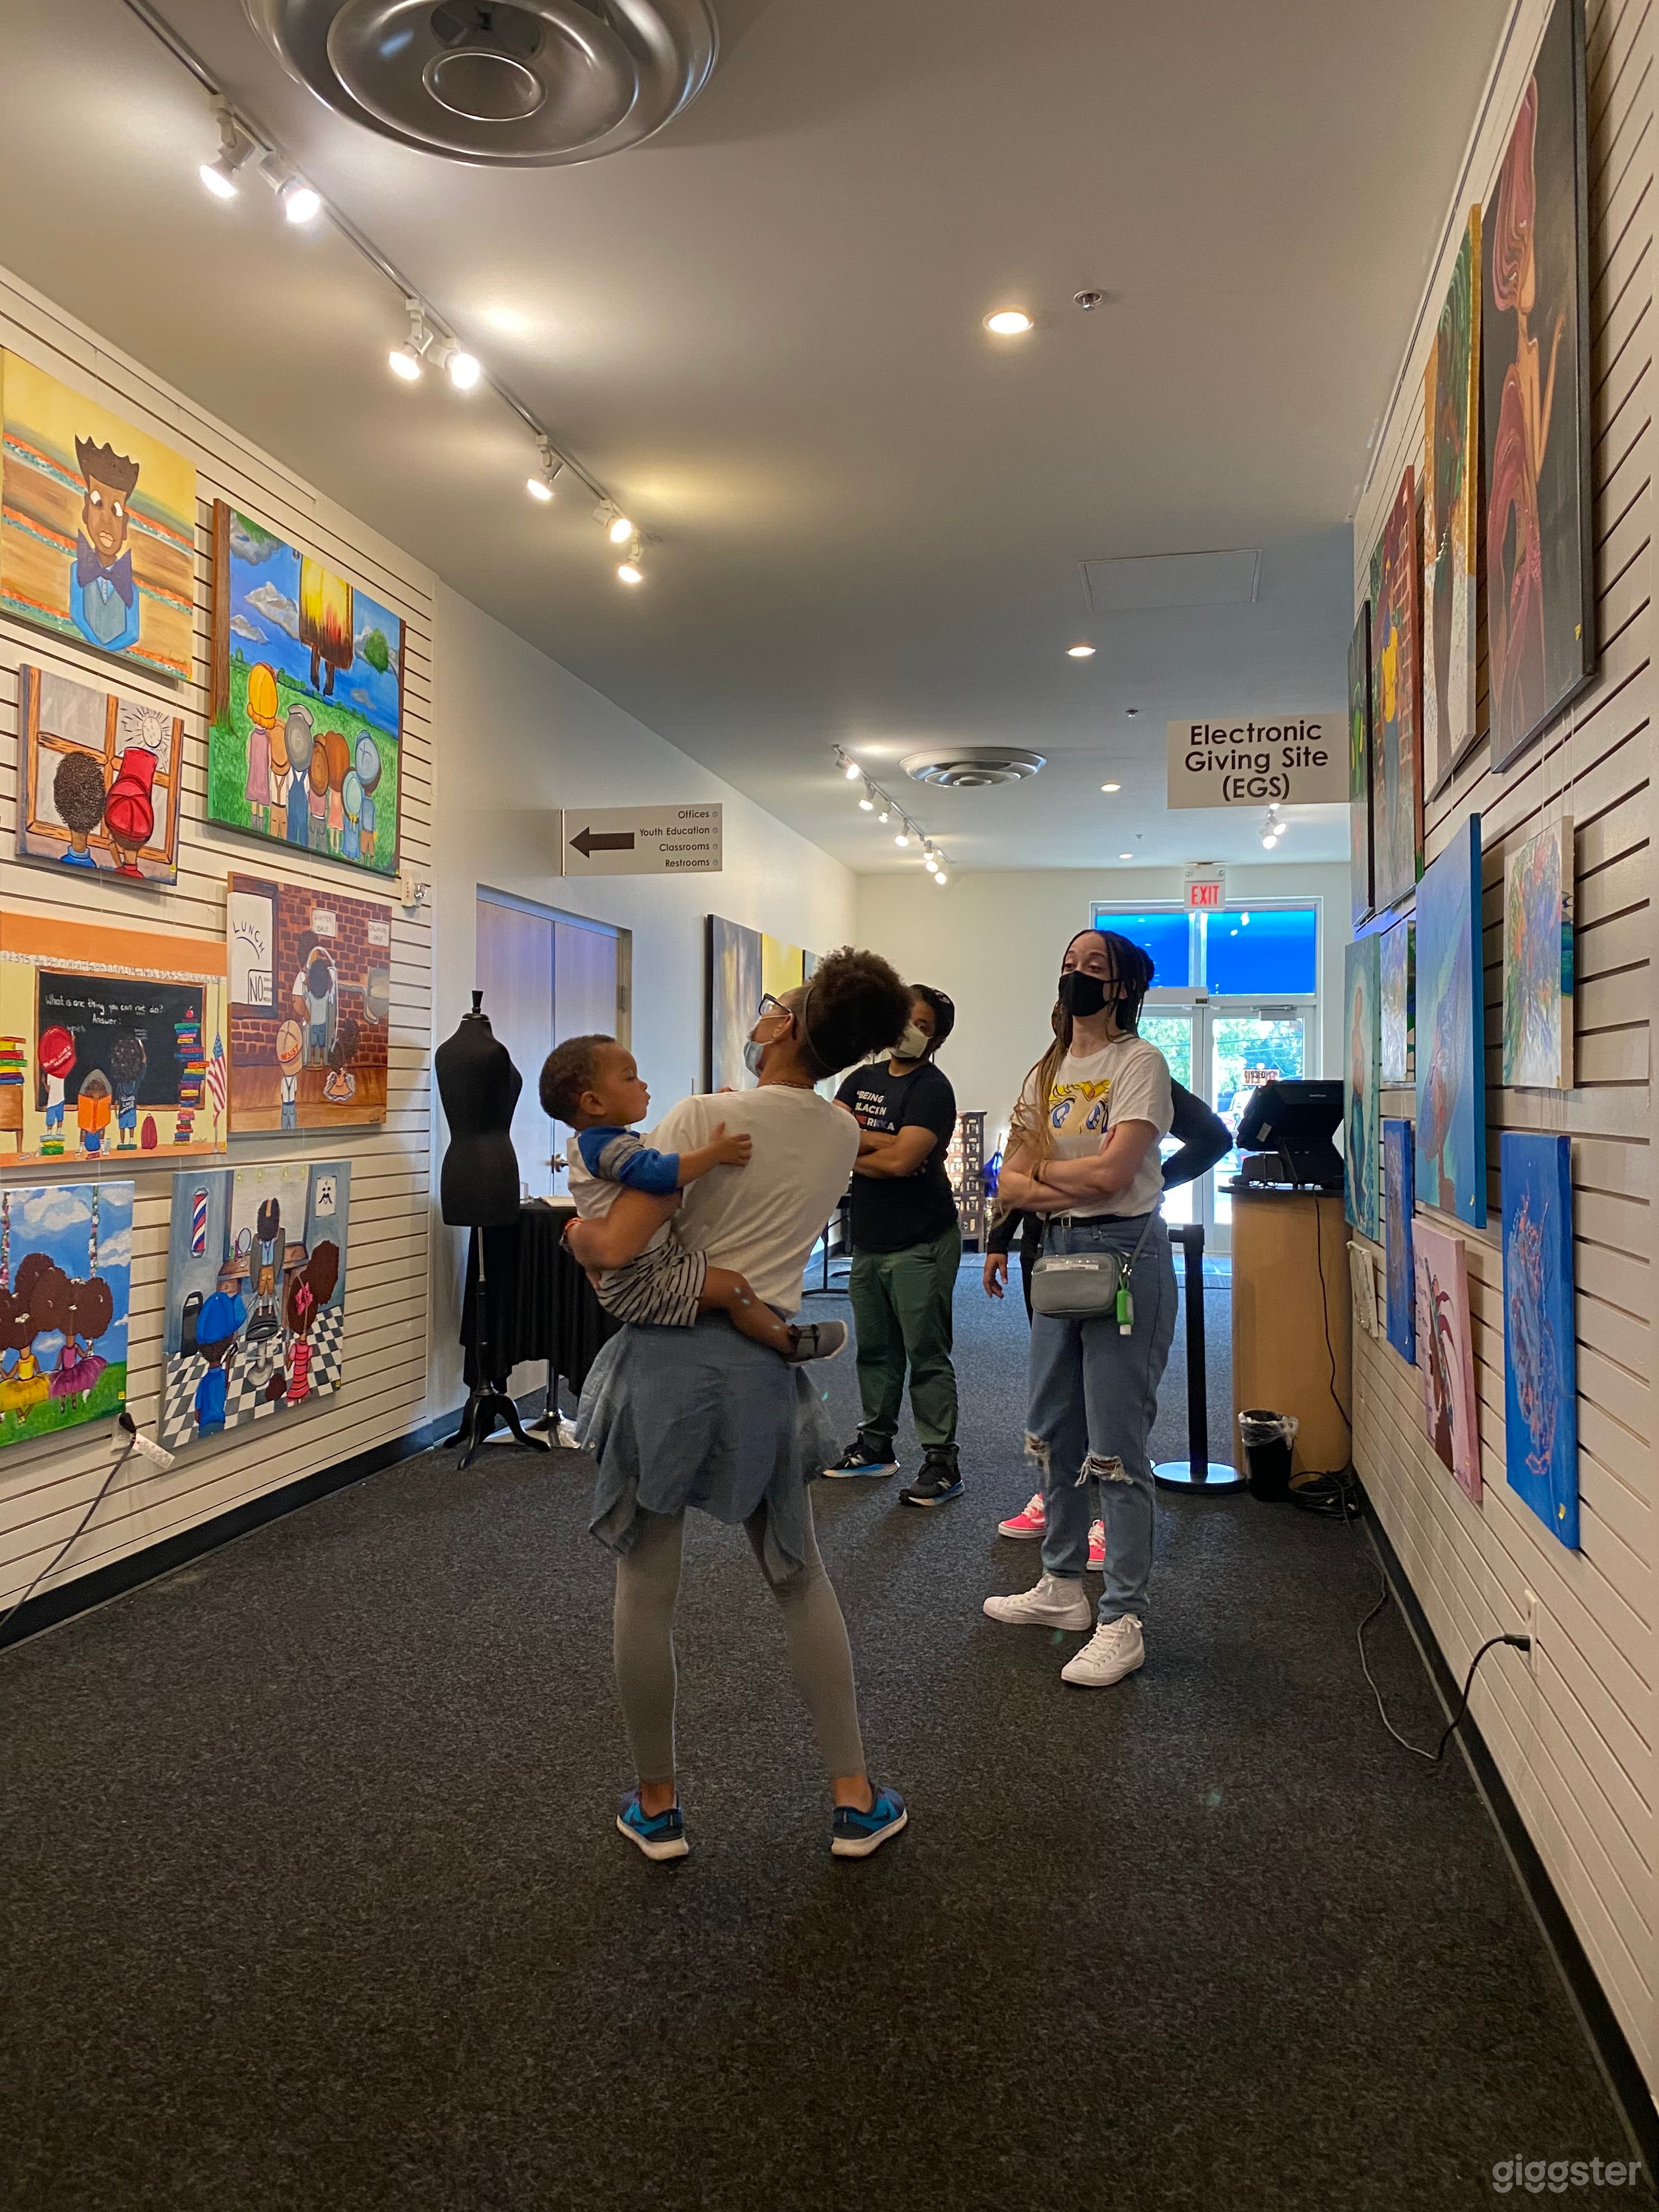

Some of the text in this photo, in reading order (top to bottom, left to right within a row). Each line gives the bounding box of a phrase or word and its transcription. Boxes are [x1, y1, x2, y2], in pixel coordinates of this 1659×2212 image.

[1191, 720, 1322, 745] Electronic
[1185, 747, 1328, 774] Giving Site
[1222, 773, 1290, 801] (EGS)
[677, 810, 710, 819] Offices
[639, 826, 710, 837] Youth Education
[659, 843, 710, 851] Classrooms
[665, 859, 710, 868] Restrooms
[1191, 885, 1219, 906] EXIT
[232, 920, 265, 953] LUNCH
[249, 976, 263, 1002] NO
[46, 994, 64, 1006] What
[88, 998, 105, 1016] thing
